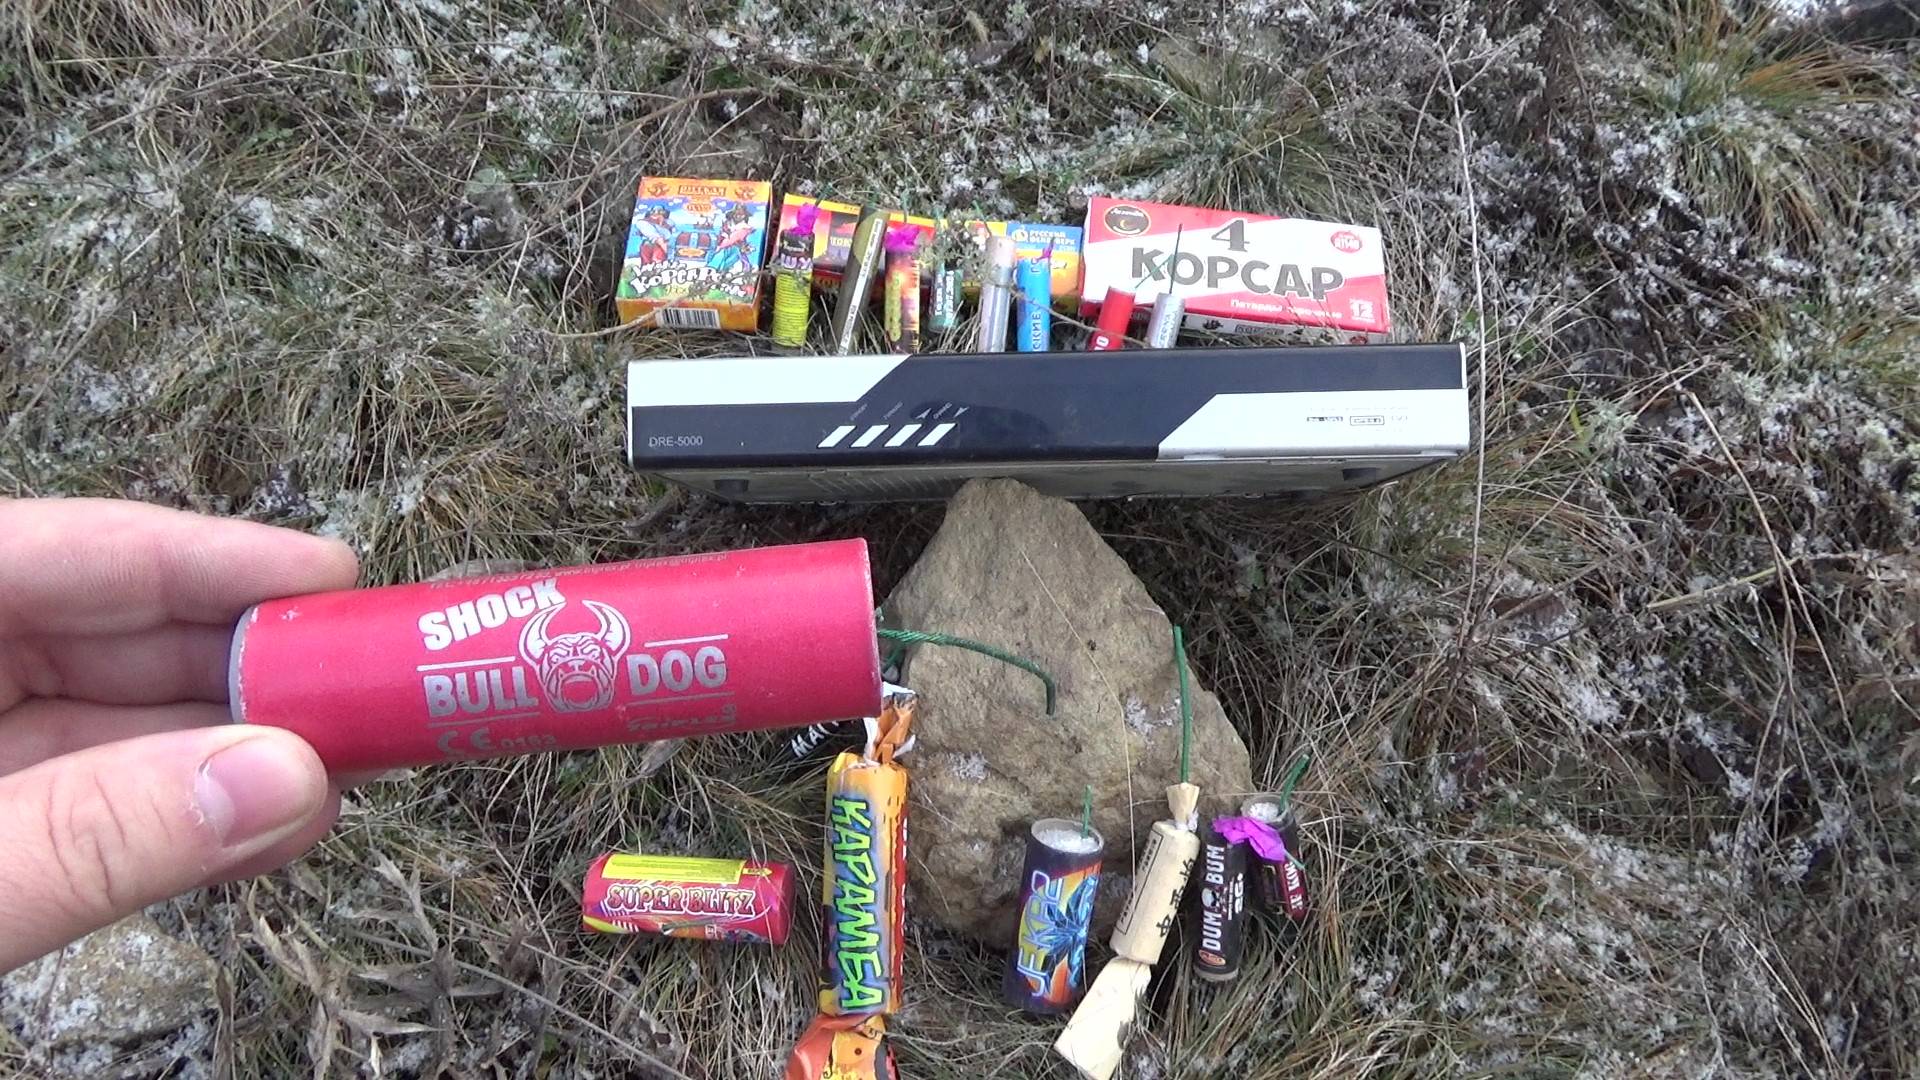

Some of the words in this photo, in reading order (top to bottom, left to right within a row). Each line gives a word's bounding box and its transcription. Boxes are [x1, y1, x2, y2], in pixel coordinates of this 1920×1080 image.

[1212, 219, 1249, 252] 4
[1131, 247, 1343, 300] КОРСАР
[1351, 301, 1374, 317] 12
[649, 435, 703, 447] DRE-5000
[417, 578, 566, 651] SHOCK
[423, 665, 539, 718] BULL
[626, 645, 728, 696] DOG
[1205, 843, 1226, 886] BUM
[607, 884, 685, 914] SUPER
[688, 887, 756, 917] BLITZ
[831, 795, 884, 1010] КАРАМБА
[1201, 911, 1222, 951] DUM
